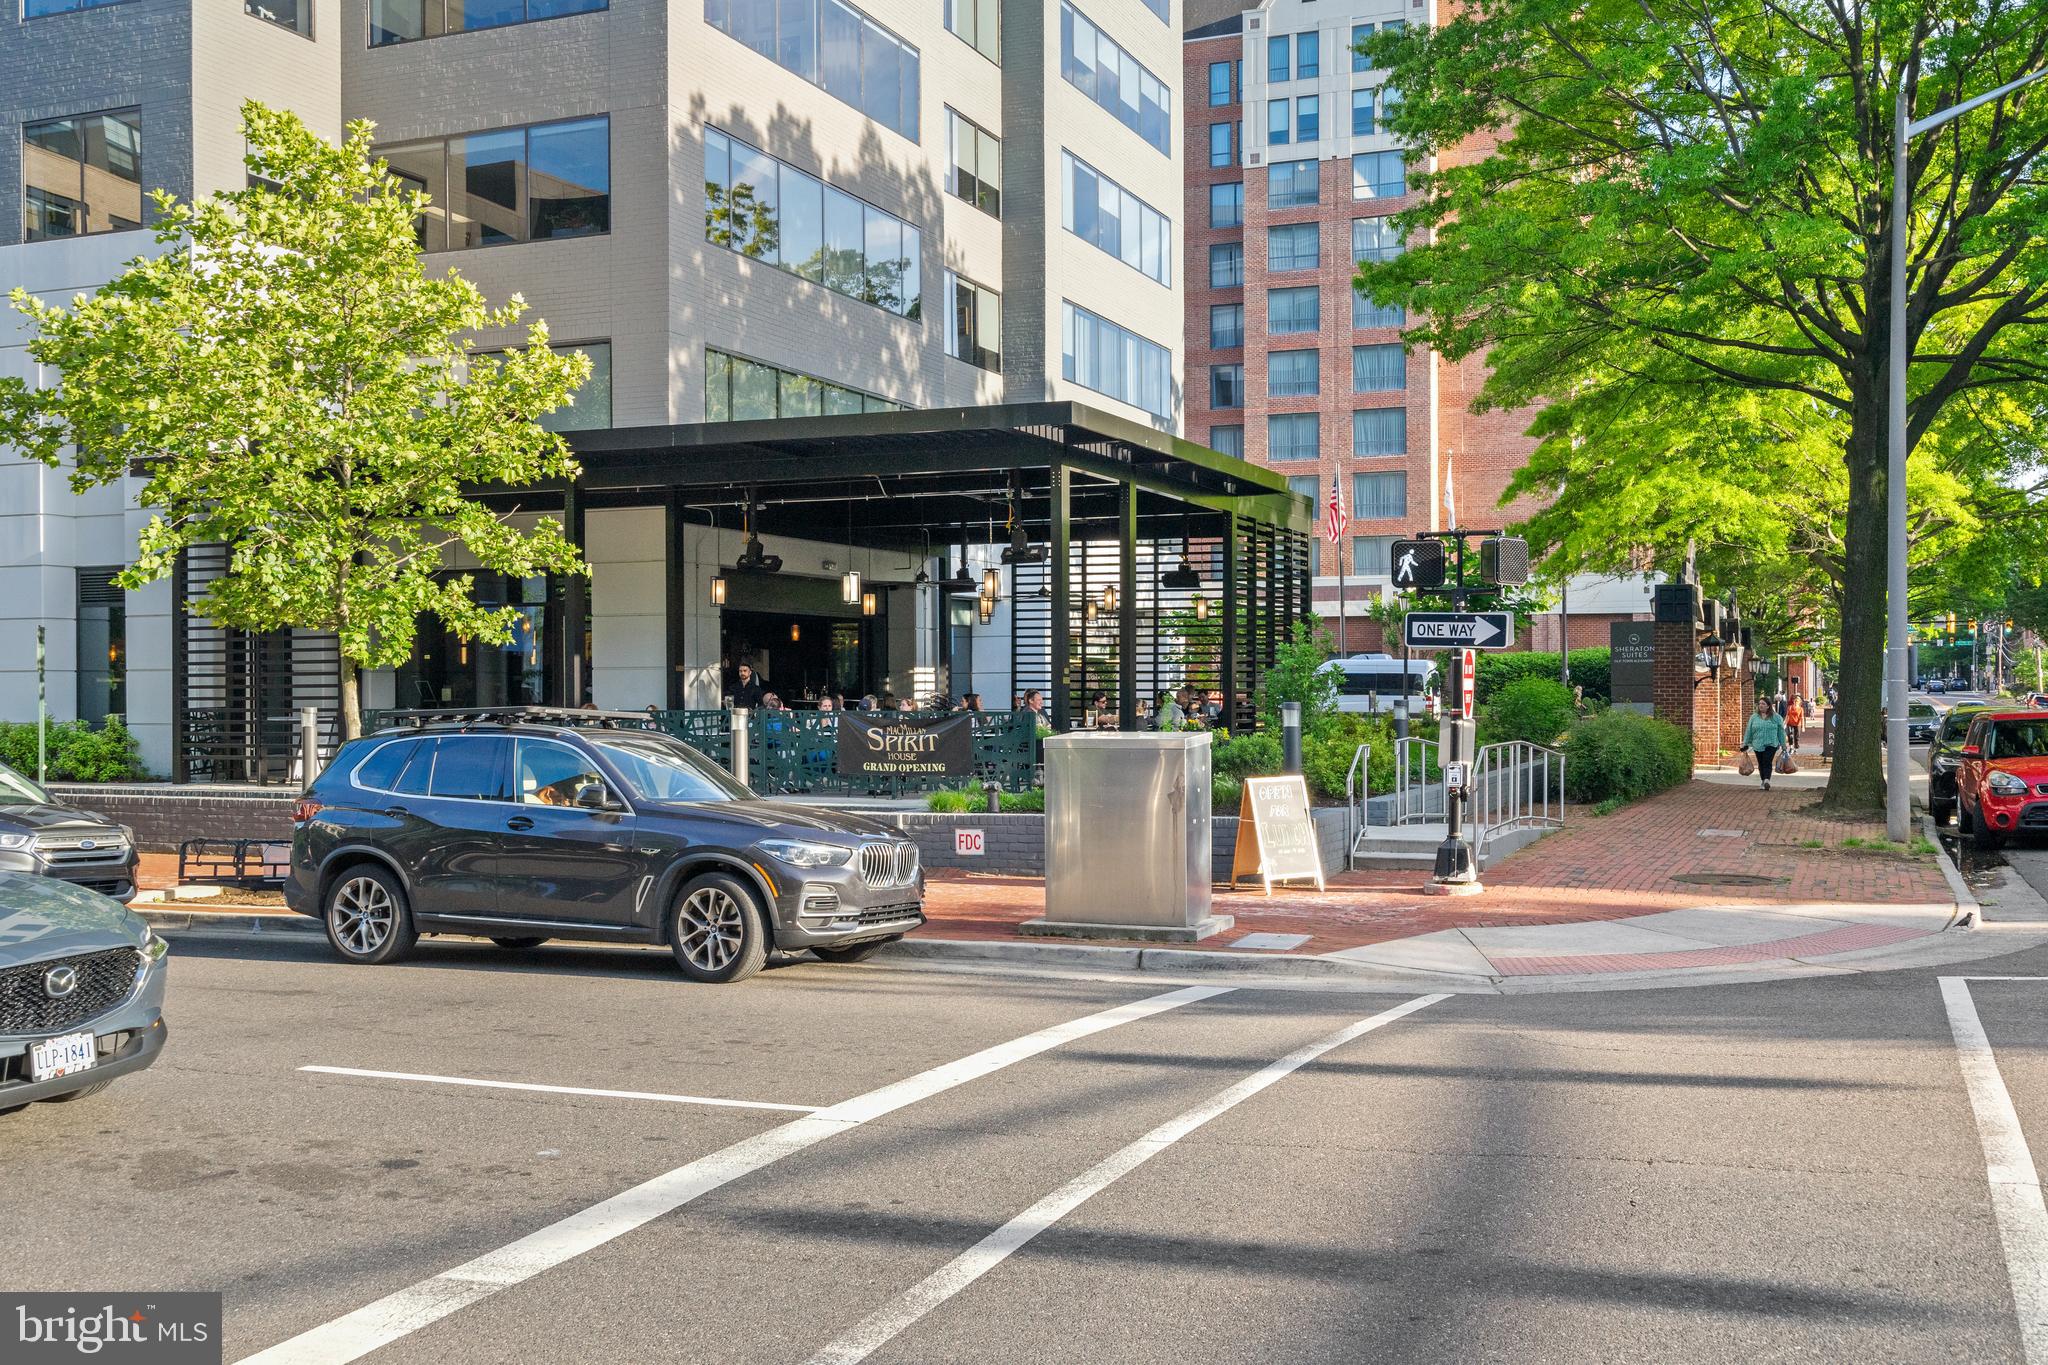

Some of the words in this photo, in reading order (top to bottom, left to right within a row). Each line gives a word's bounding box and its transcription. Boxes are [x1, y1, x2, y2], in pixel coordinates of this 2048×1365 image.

[1417, 624, 1444, 636] ONE
[1449, 624, 1476, 637] WAY
[1614, 645, 1656, 653] SHERATON
[1621, 651, 1648, 659] SUITES
[867, 727, 938, 752] SPIRIT
[888, 752, 917, 761] HOUSE
[863, 762, 897, 772] GRAND
[899, 763, 946, 772] OPENING
[958, 833, 982, 850] FDC
